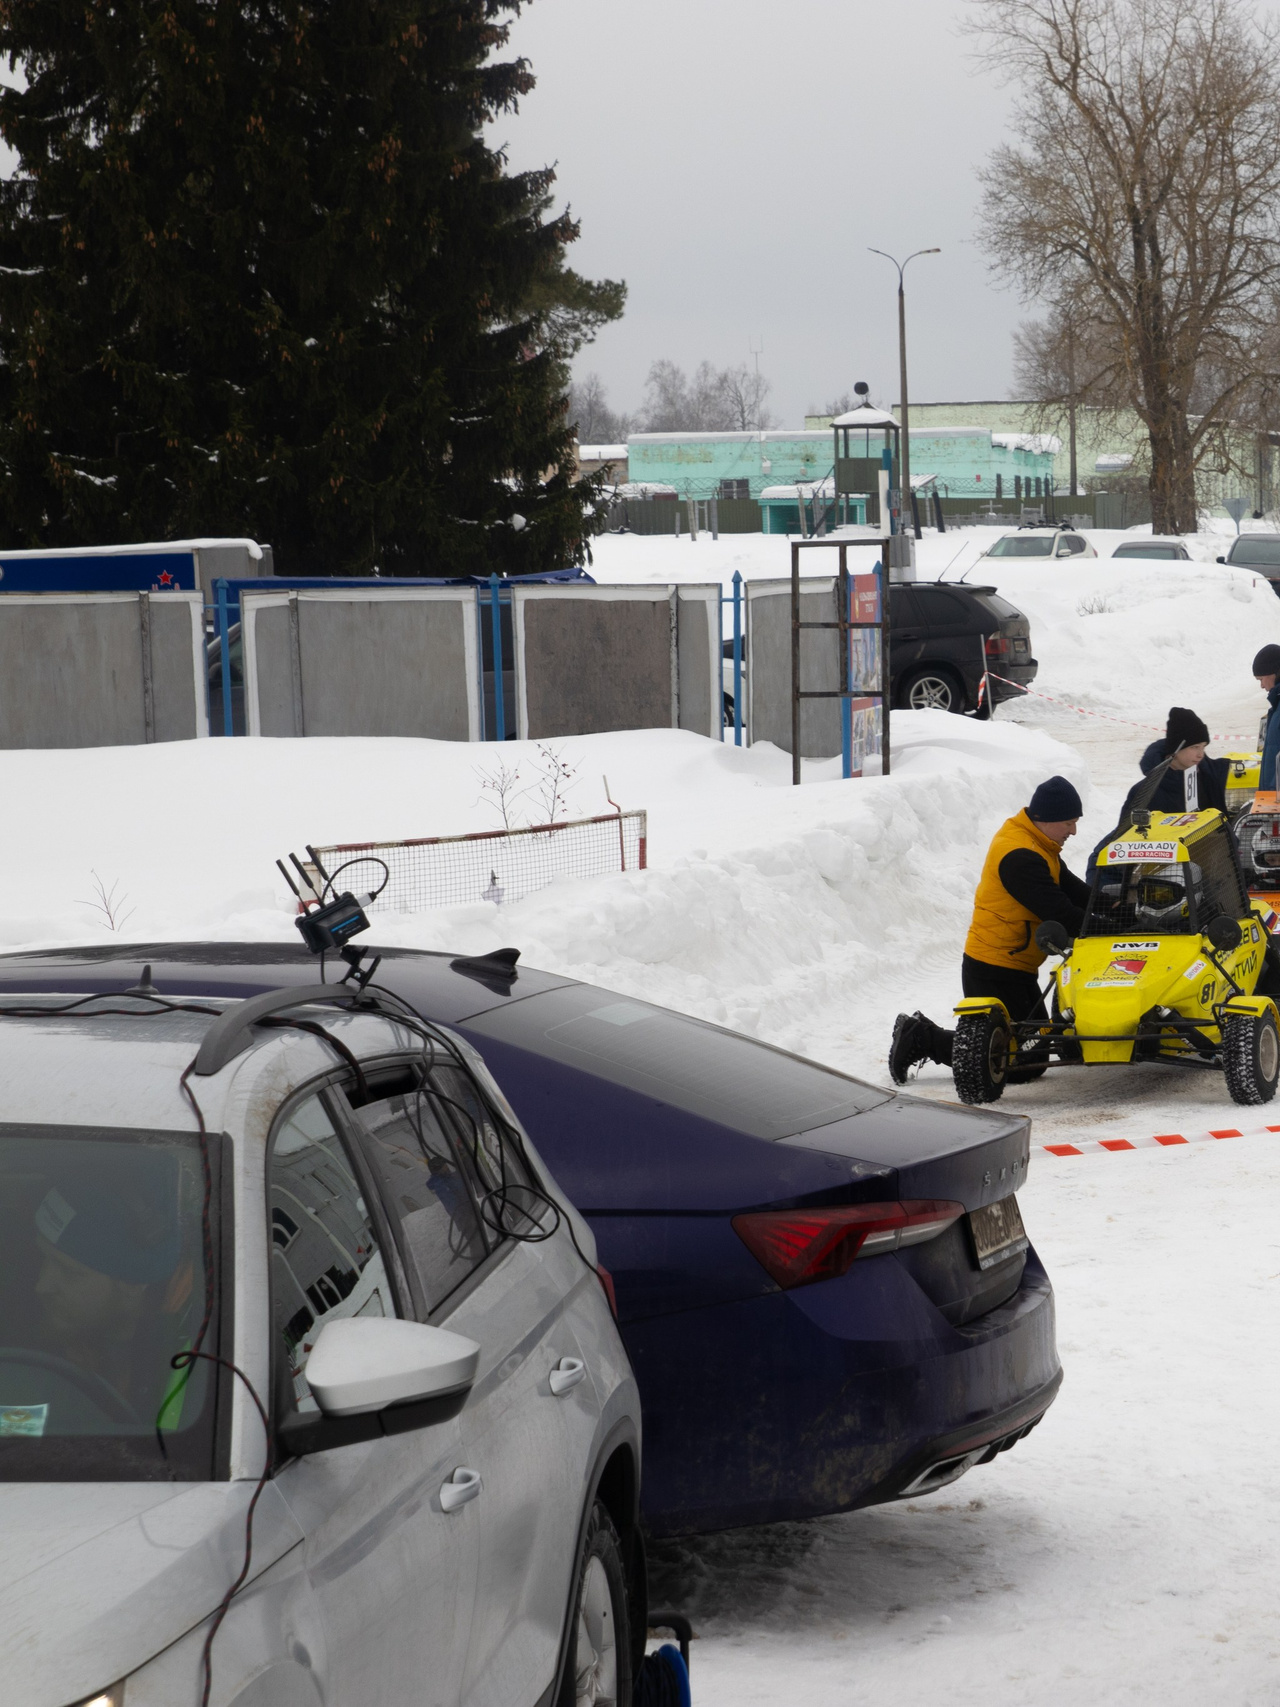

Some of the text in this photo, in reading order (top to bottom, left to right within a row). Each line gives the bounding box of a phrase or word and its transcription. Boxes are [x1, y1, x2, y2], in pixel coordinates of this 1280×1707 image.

[1187, 770, 1196, 801] 81
[1127, 842, 1177, 850] YUKA ADV
[1200, 980, 1216, 1005] 81
